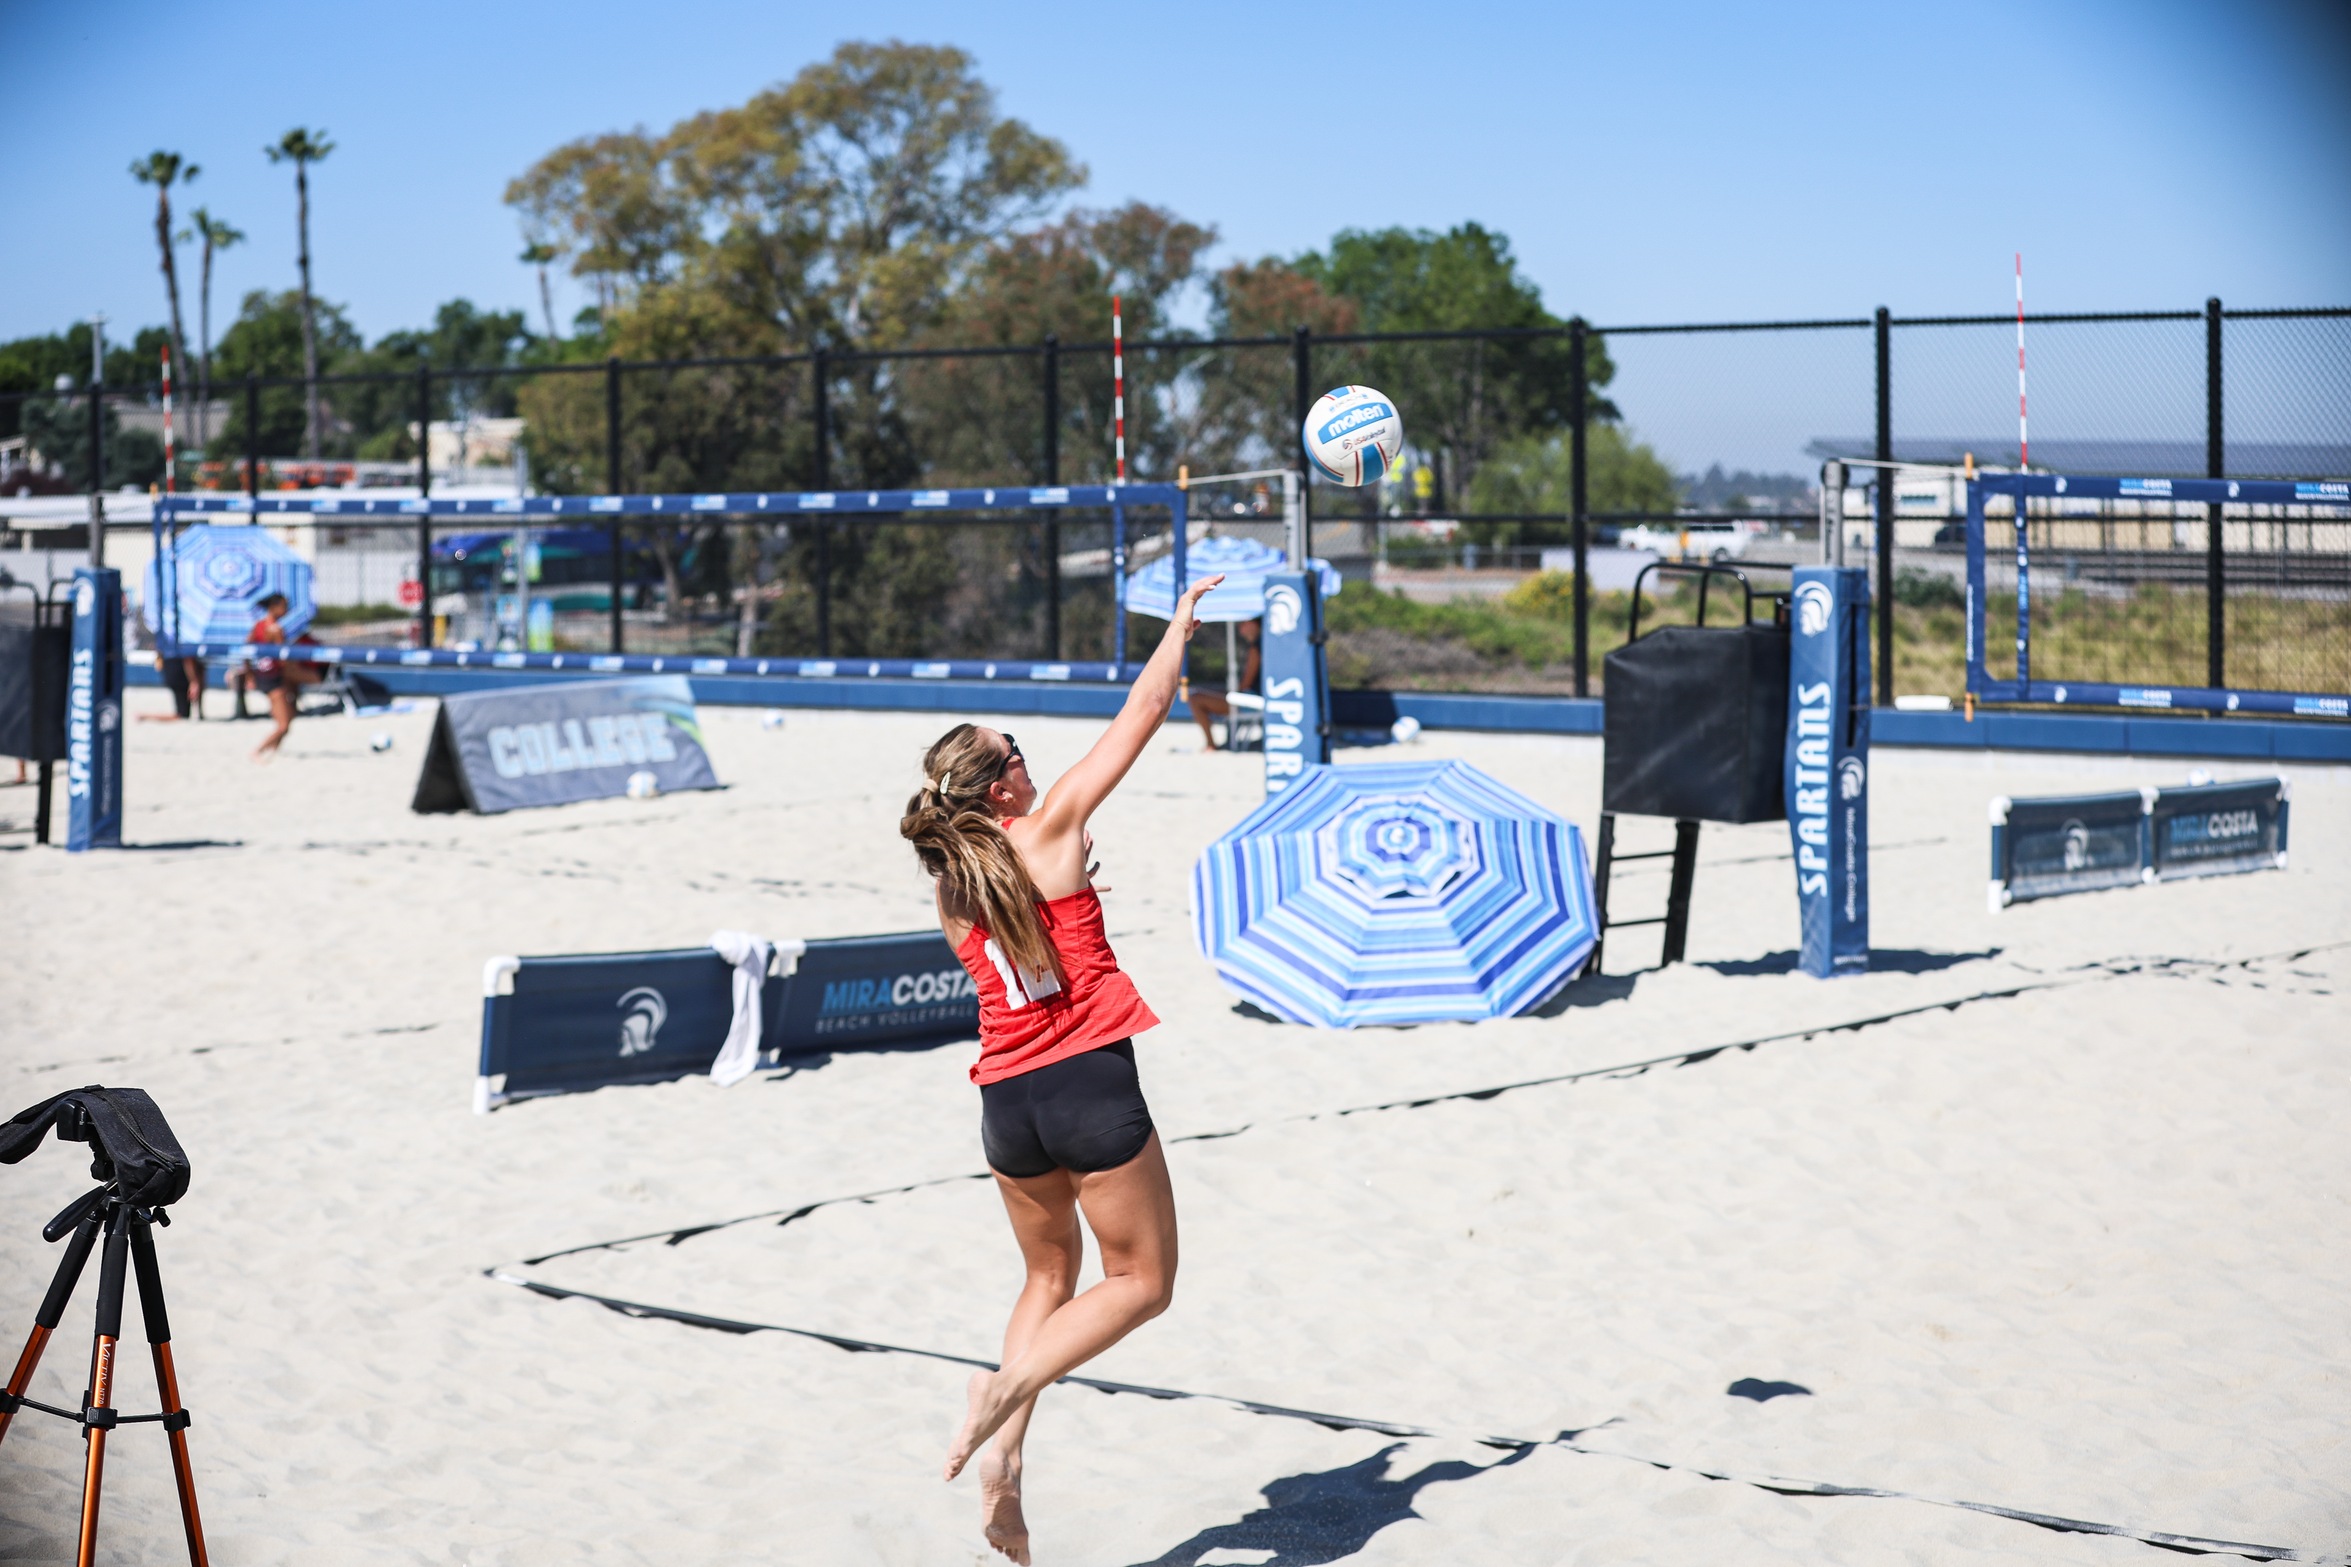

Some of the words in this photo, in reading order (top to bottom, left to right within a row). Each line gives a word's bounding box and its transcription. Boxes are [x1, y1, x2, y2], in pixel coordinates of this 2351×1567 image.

[1328, 404, 1384, 437] molten
[487, 712, 677, 779] COLLEGE
[1795, 681, 1831, 898] SPARTANS
[822, 970, 980, 1011] MIRACOSTA
[815, 1013, 872, 1034] BEACH
[878, 1003, 976, 1026] VOLLEYBALL
